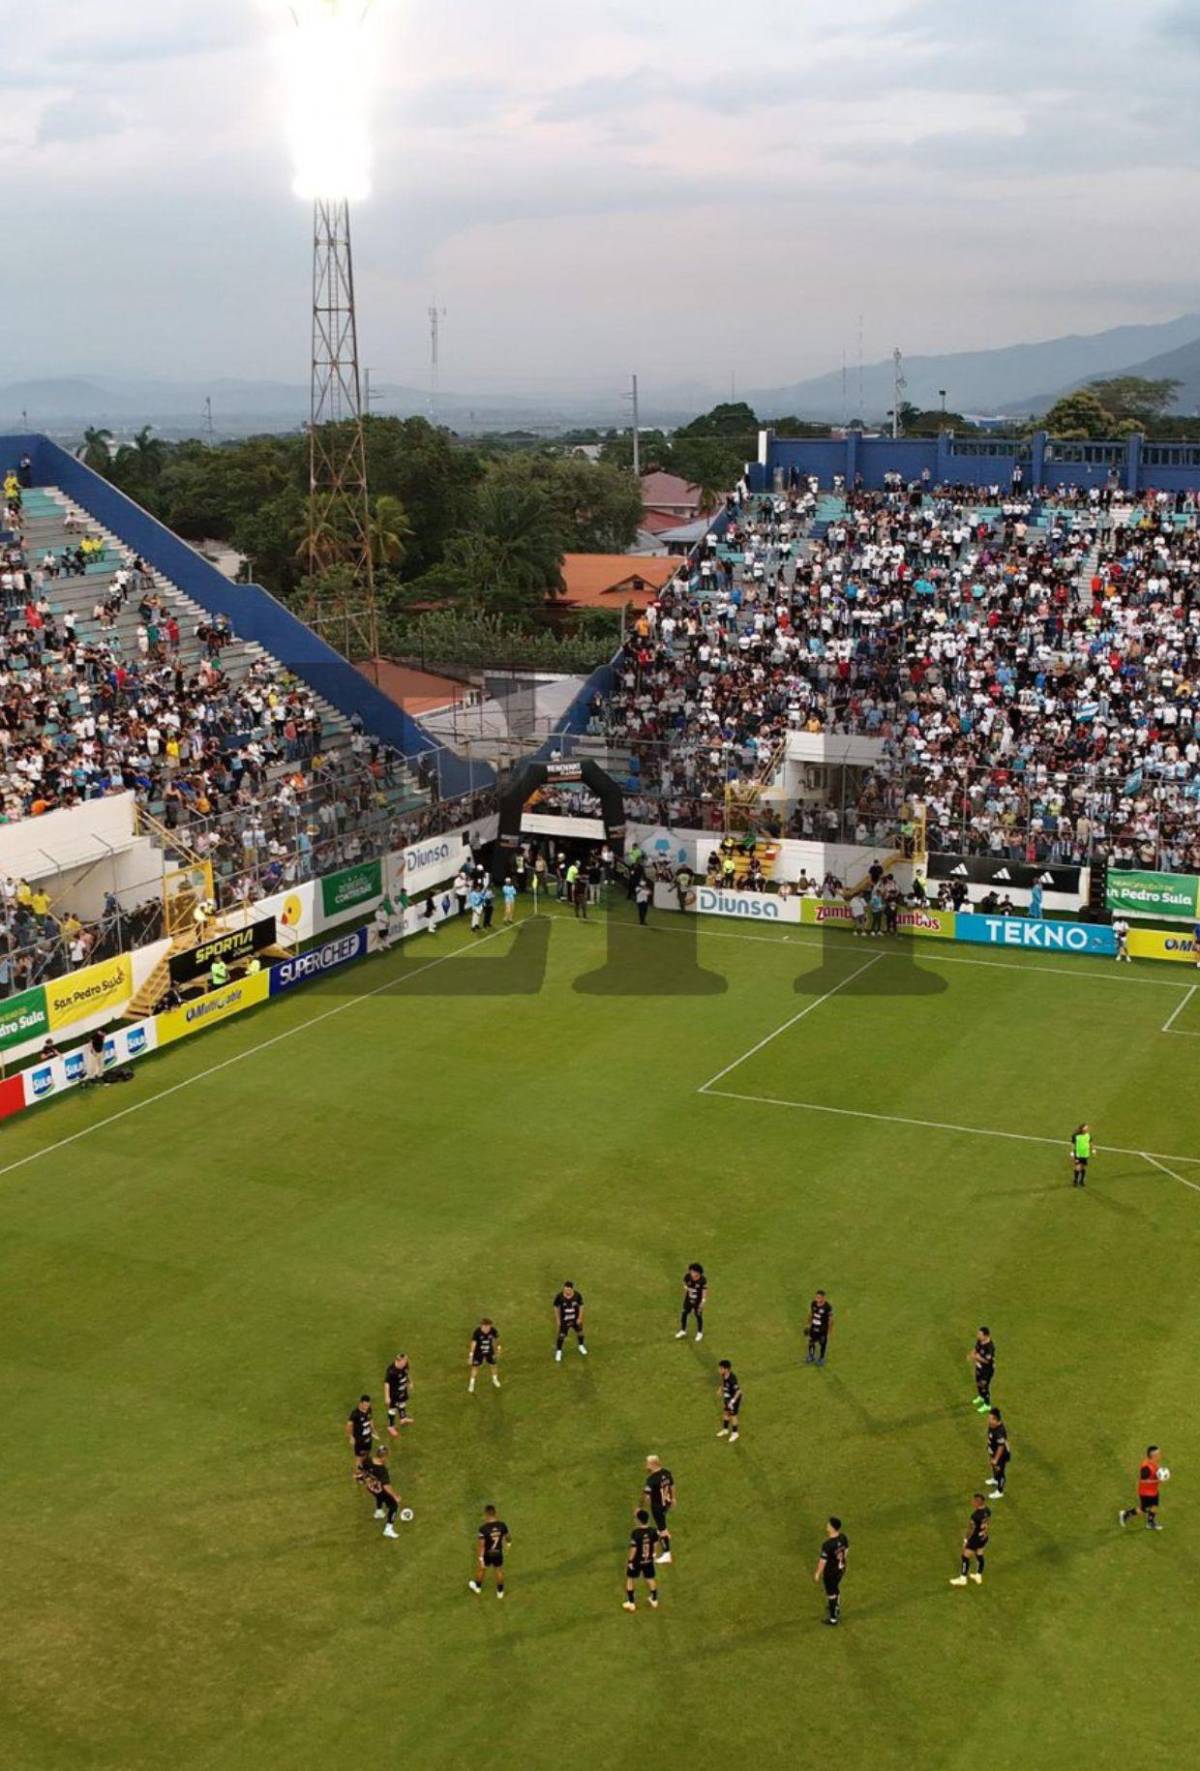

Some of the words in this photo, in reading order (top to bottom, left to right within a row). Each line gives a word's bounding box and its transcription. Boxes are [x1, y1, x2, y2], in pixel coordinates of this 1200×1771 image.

[407, 842, 449, 871] Diunsa
[699, 889, 779, 918] Diunsa
[1120, 888, 1160, 902] Pedro
[1161, 892, 1192, 906] Sula
[814, 904, 853, 922] Zamb
[895, 911, 941, 931] ambos
[195, 928, 254, 964] SPORTIA
[985, 919, 1088, 949] TEKNO
[54, 995, 73, 1011] San
[74, 985, 102, 1003] Pedro
[102, 974, 126, 992] Sula
[0, 1021, 18, 1038] dro
[18, 1010, 46, 1030] Sula
